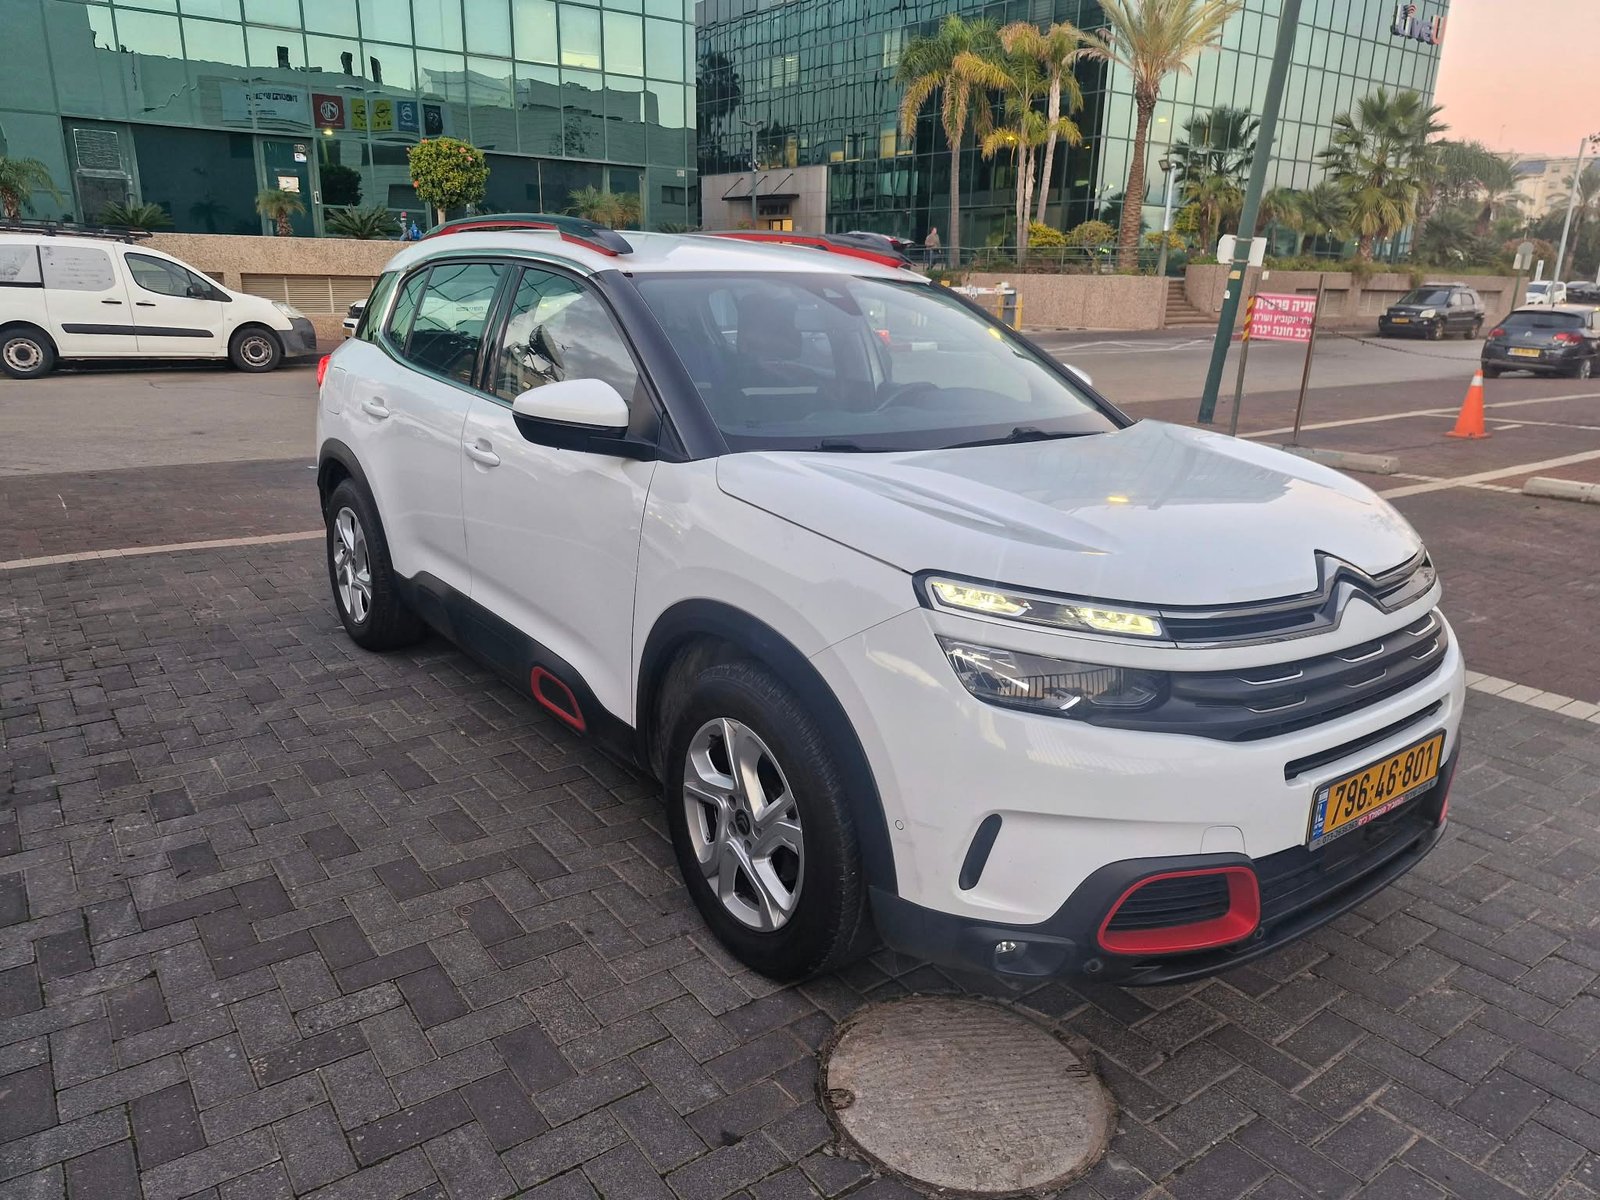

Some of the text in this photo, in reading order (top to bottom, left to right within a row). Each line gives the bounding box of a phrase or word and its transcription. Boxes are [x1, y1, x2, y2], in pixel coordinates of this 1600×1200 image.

[1391, 3, 1447, 45] LiveU
[1292, 300, 1316, 313] חניה
[1272, 325, 1294, 337] חונה
